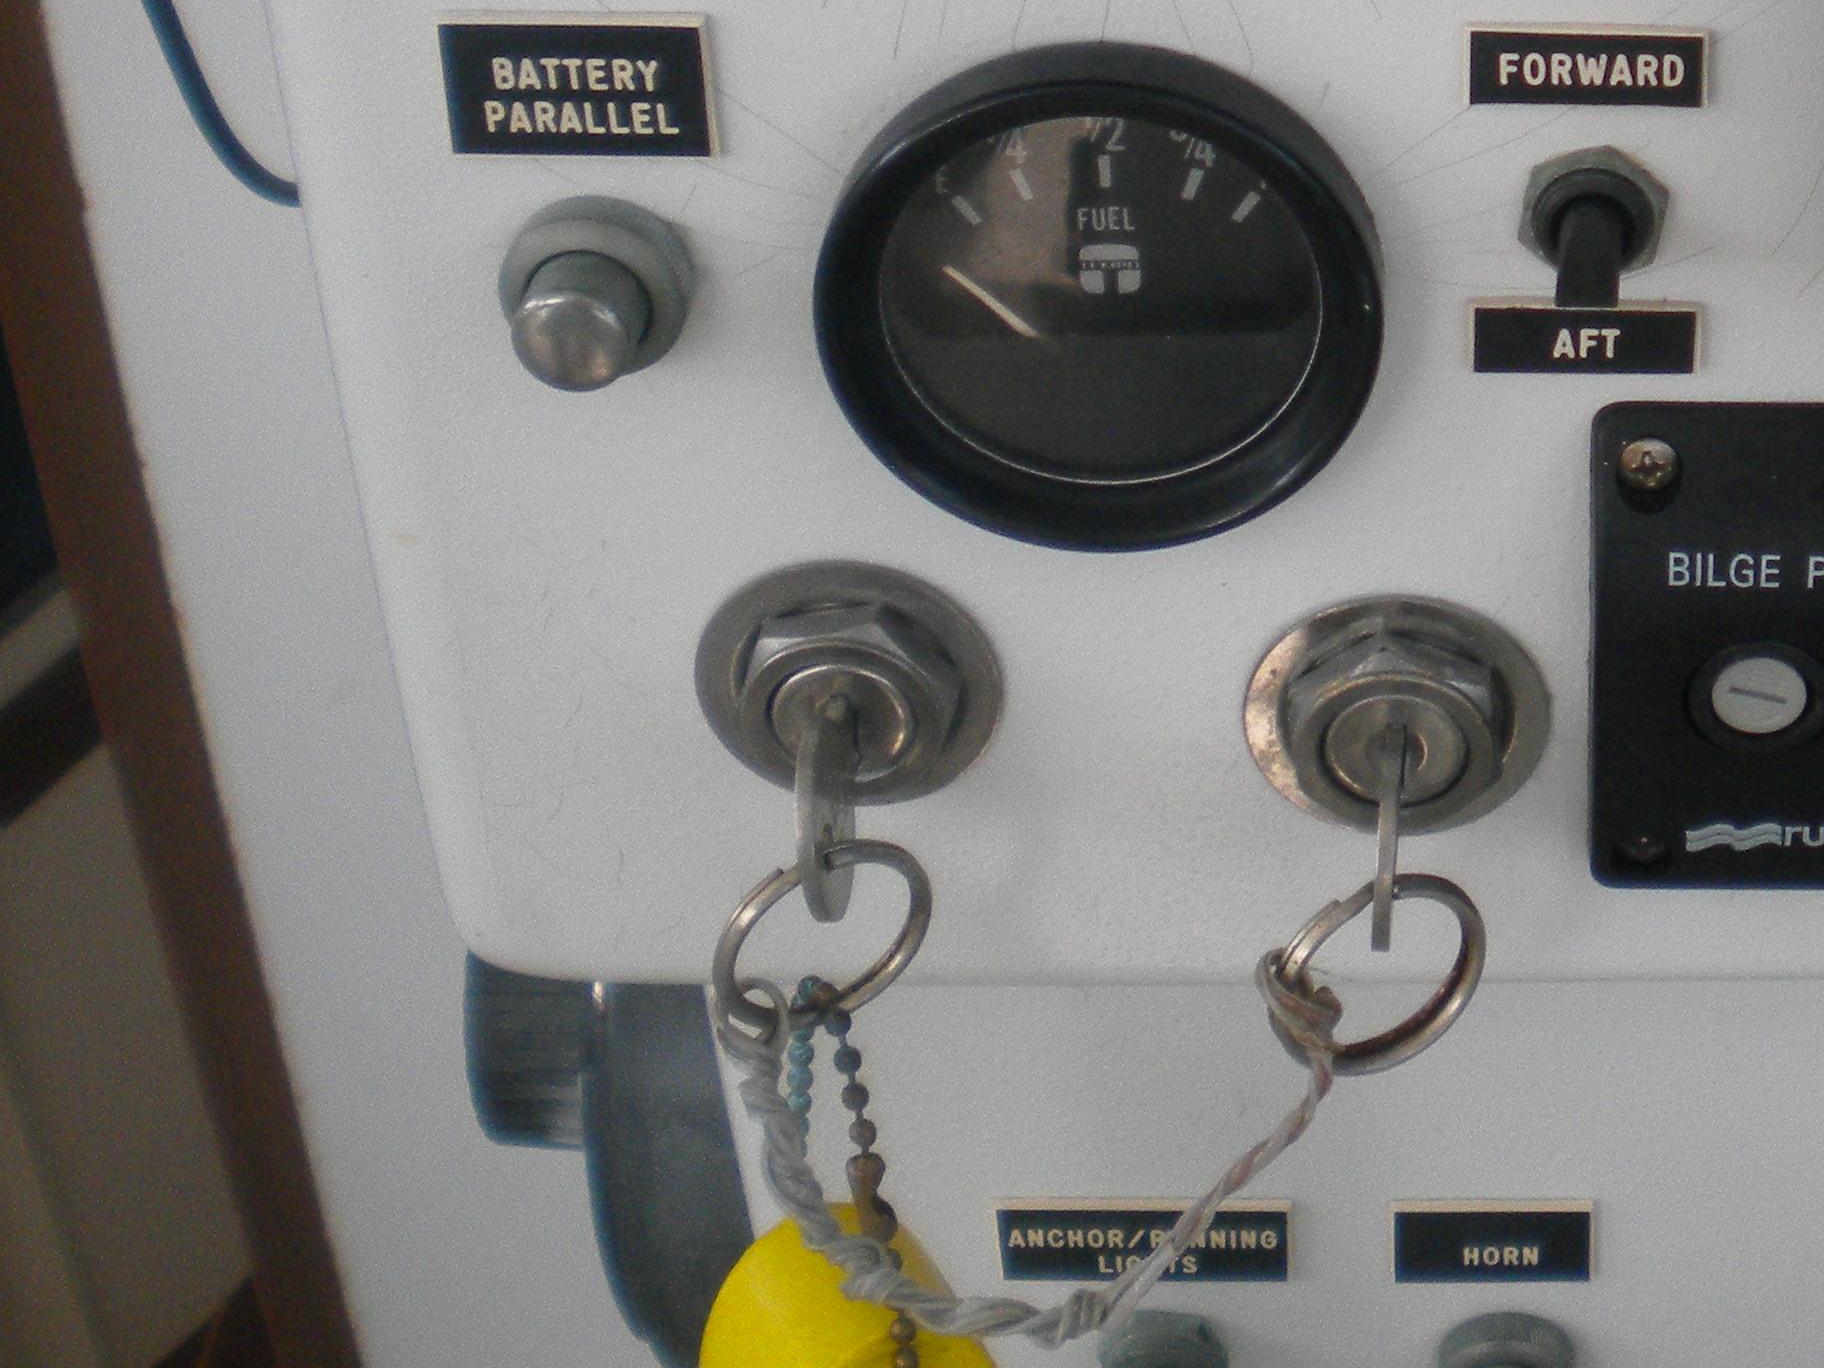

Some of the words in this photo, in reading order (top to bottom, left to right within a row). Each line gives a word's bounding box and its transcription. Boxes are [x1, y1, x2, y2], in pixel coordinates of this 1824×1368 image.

[491, 57, 658, 92] BATTERY
[1499, 52, 1685, 87] FORWARD
[484, 100, 680, 135] PARALLEL
[1077, 205, 1135, 232] FUEL
[1552, 328, 1621, 359] AFT
[1668, 551, 1781, 588] BILGE
[1006, 1227, 1279, 1250] ANCHOR/RNNING
[1097, 1254, 1199, 1275] LITS
[1463, 1246, 1539, 1266] HORN
